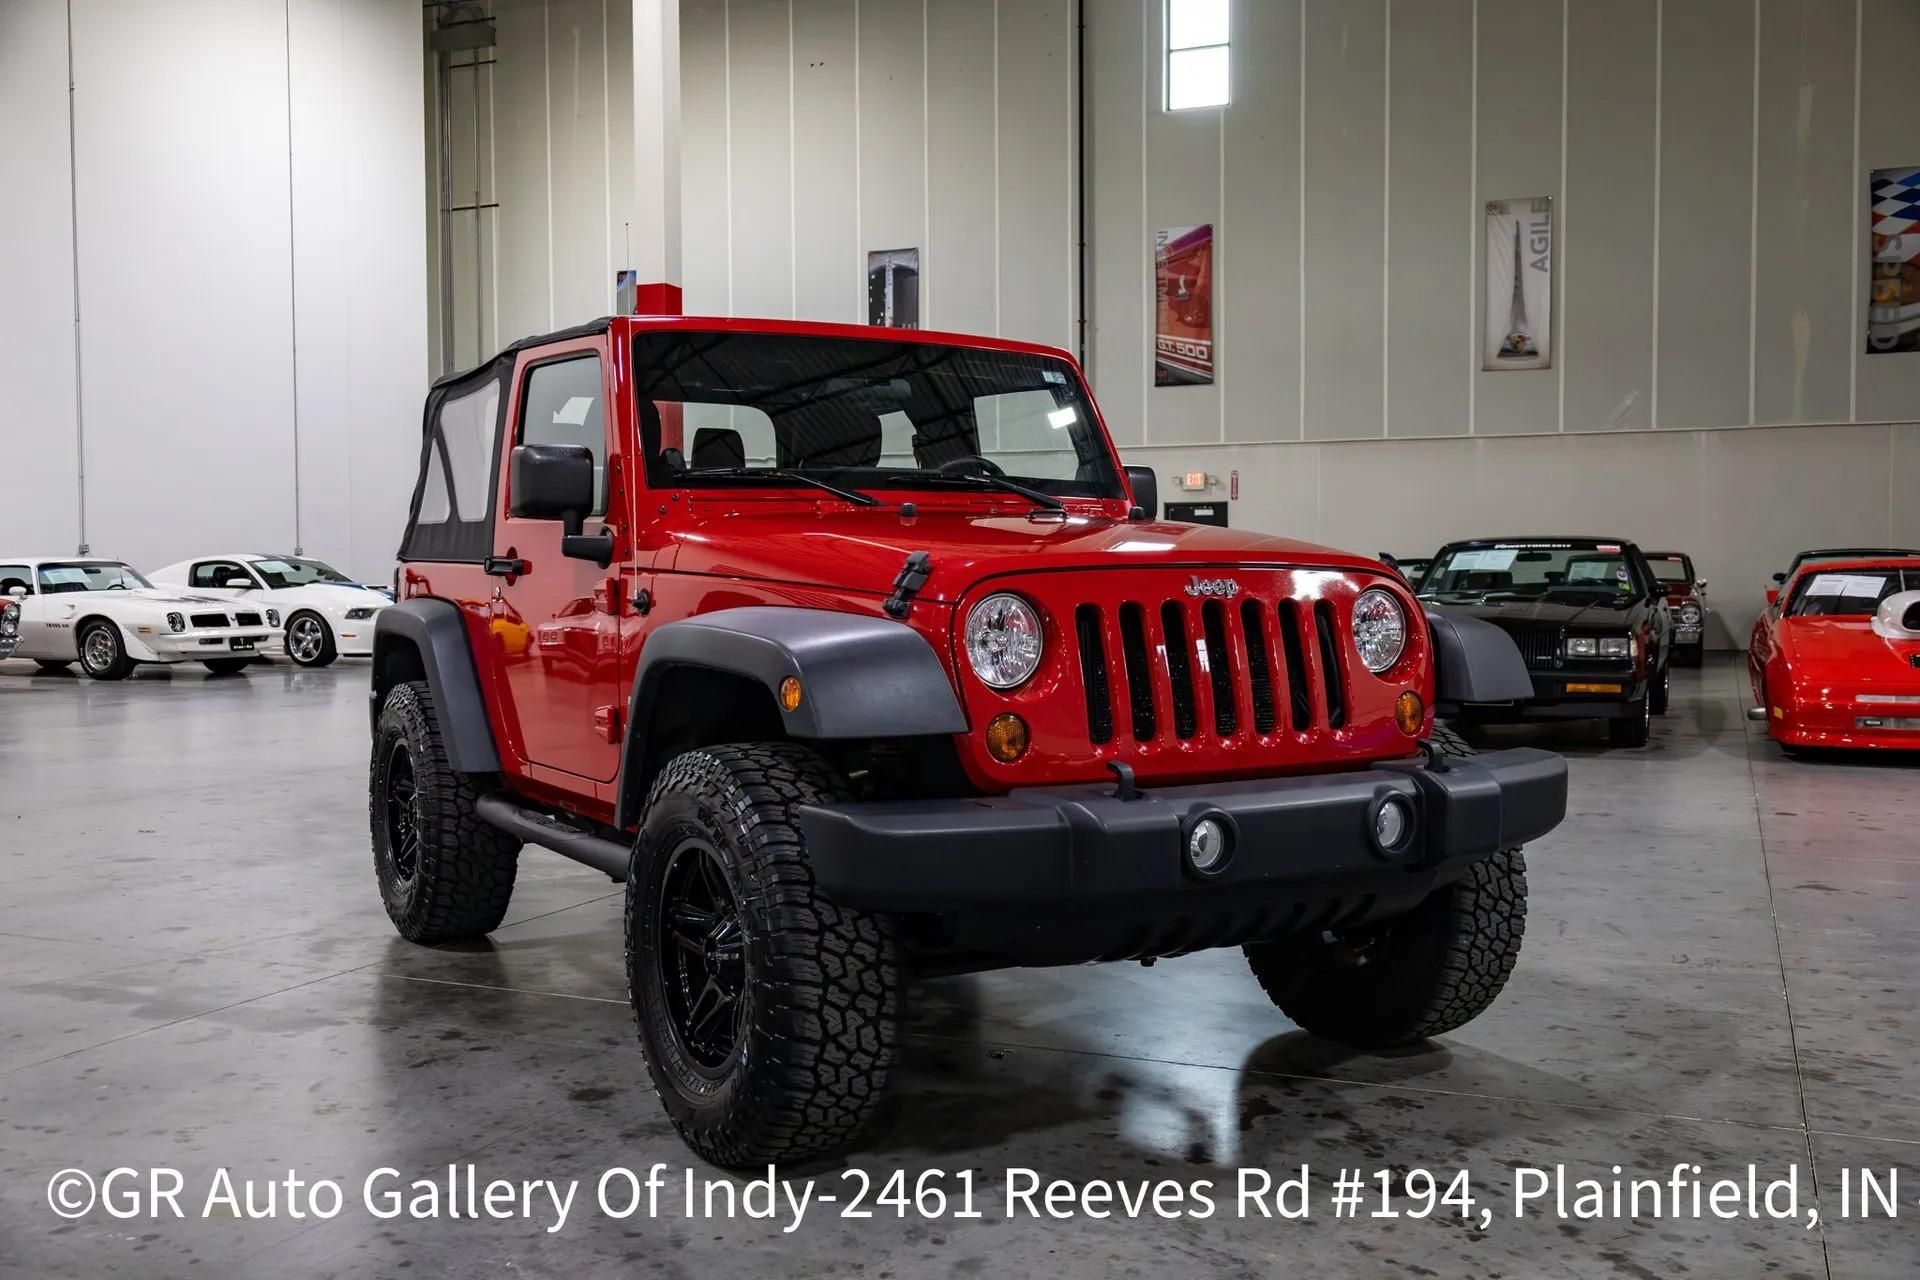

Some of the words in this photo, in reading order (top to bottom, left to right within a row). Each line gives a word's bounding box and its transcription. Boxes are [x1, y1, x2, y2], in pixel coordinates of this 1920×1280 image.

[1530, 199, 1551, 273] AGILE
[1186, 473, 1203, 485] EXIT
[1184, 574, 1239, 599] Jeep
